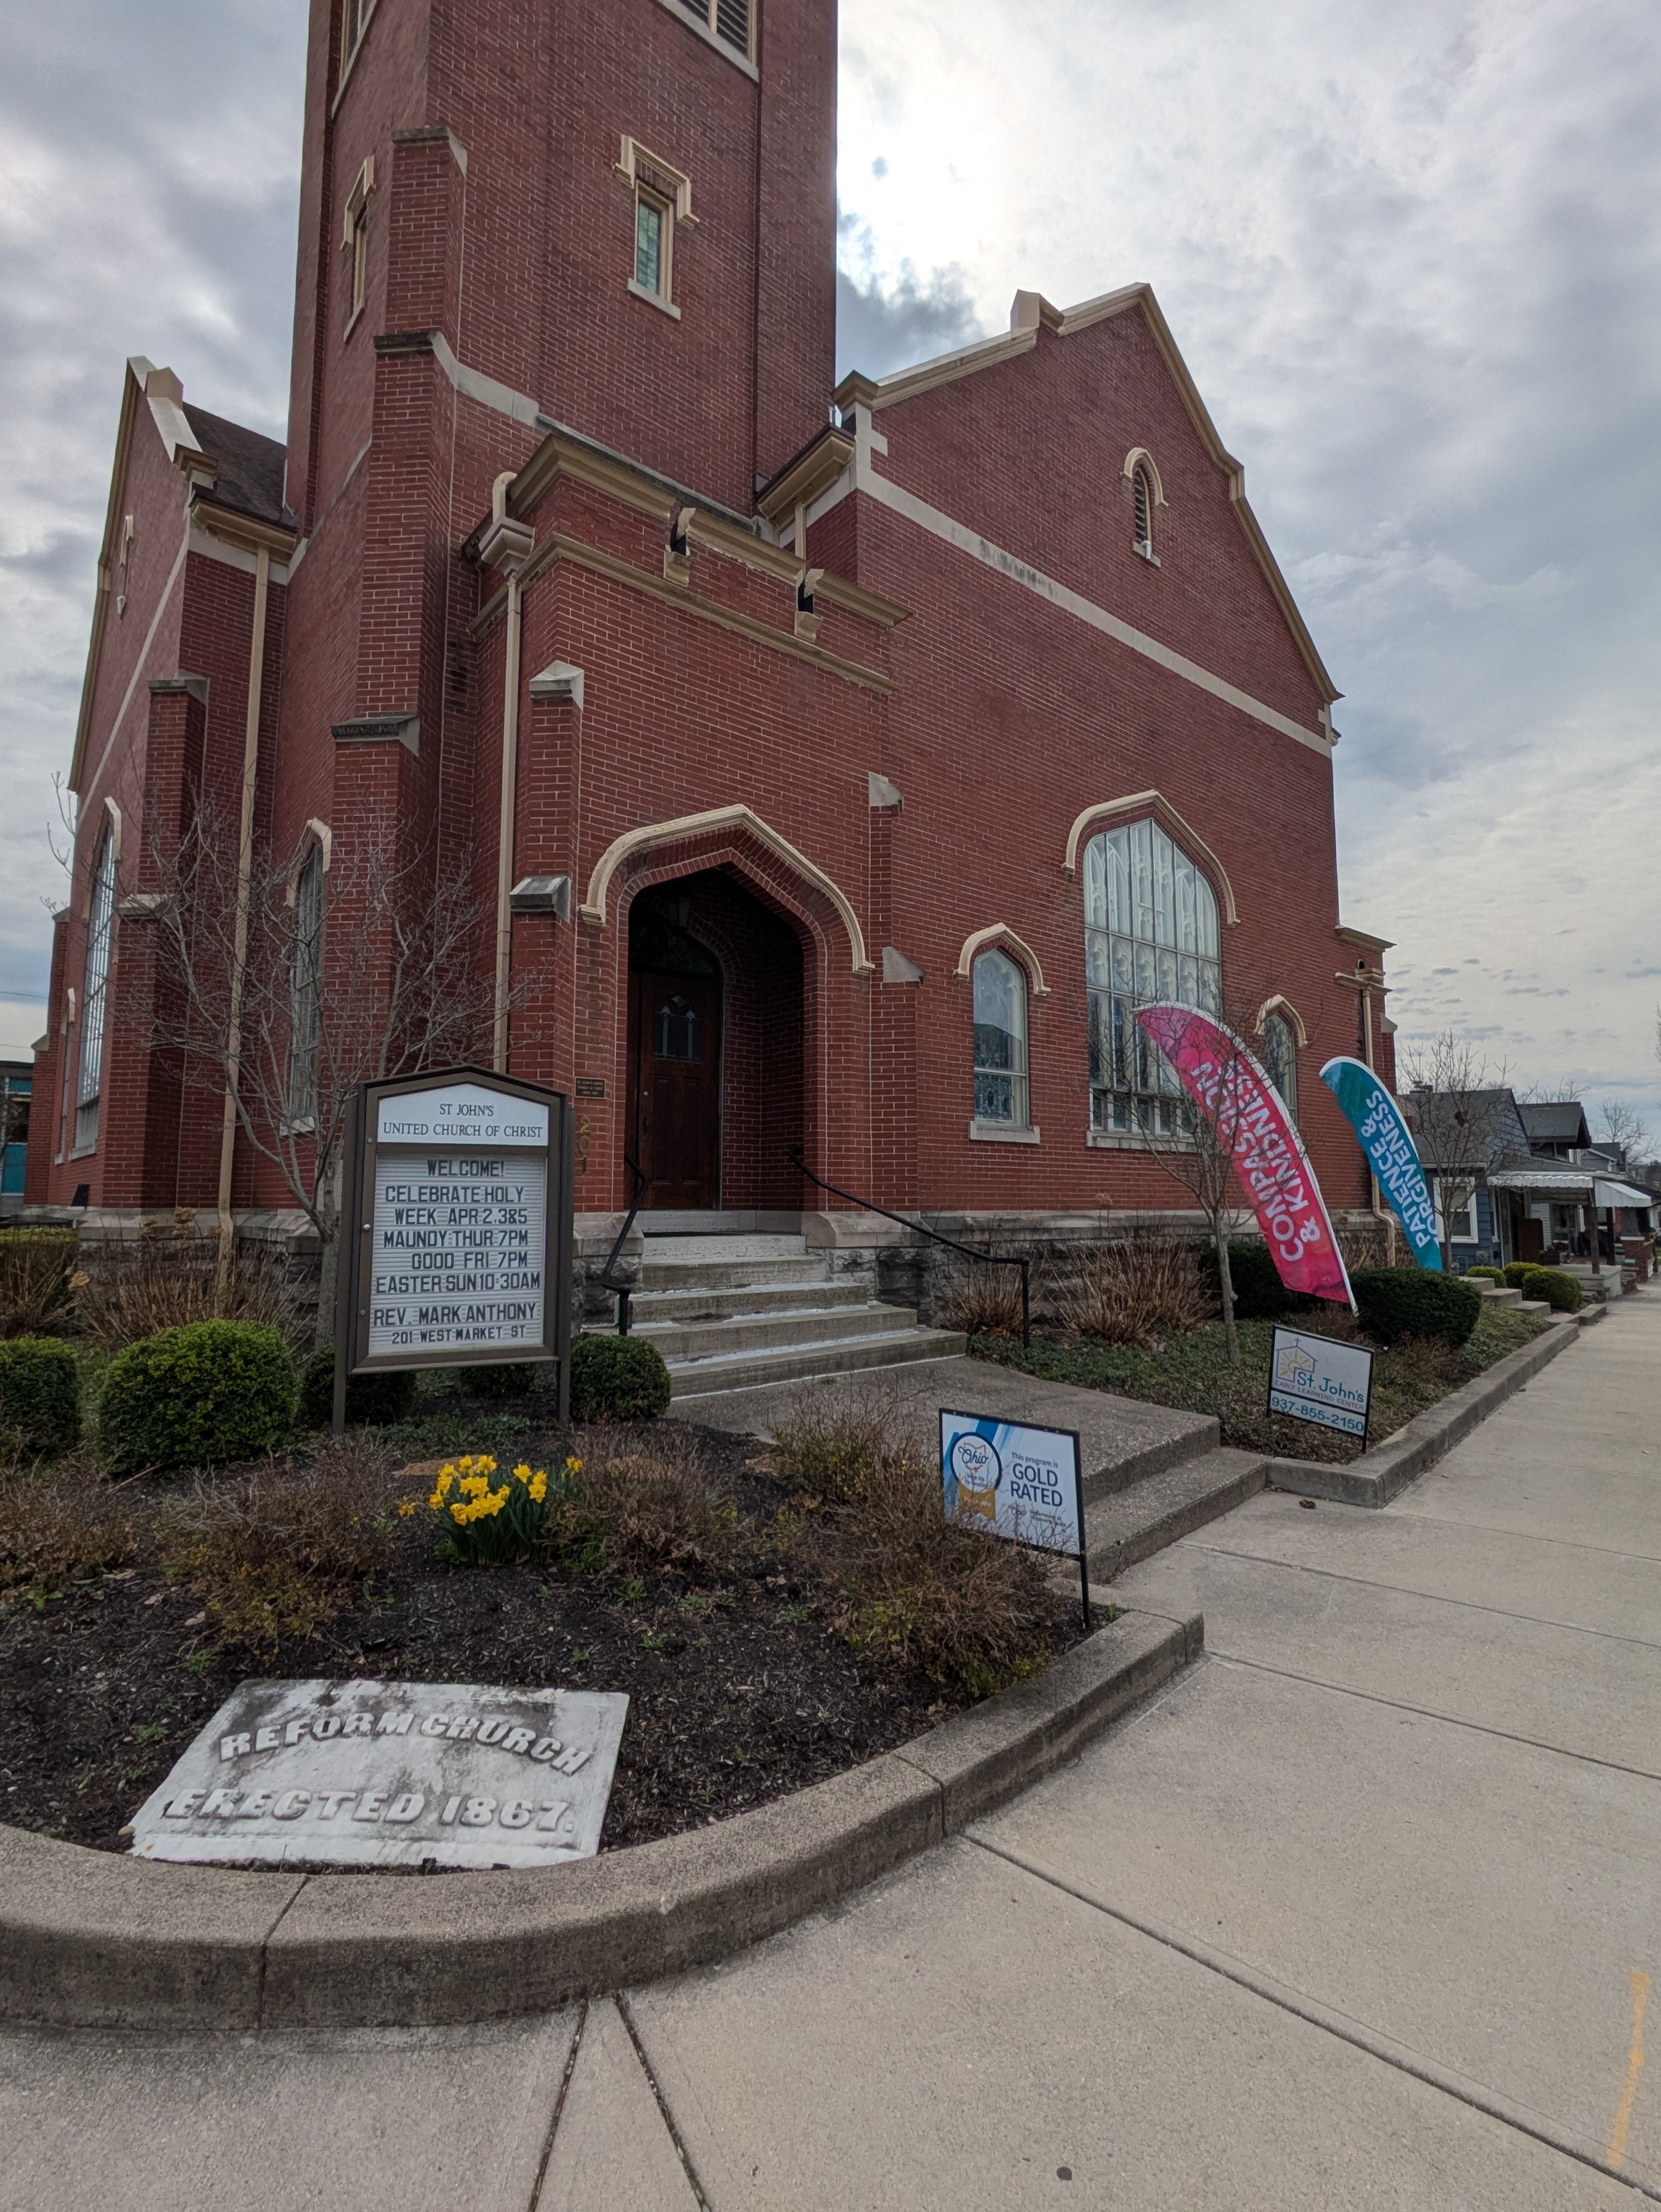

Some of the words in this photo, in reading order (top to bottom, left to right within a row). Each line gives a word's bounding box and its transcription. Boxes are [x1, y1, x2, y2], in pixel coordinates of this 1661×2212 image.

[440, 1104, 453, 1115] ST
[456, 1104, 494, 1117] JOHN'S
[383, 1123, 428, 1135] UNITED
[433, 1124, 481, 1136] CHURCH
[486, 1126, 500, 1137] OF
[504, 1126, 543, 1138] CHRIST
[1361, 1115, 1377, 1137] &
[427, 1160, 505, 1177] WELCOME!
[386, 1186, 480, 1203] CELEBRATE
[485, 1186, 524, 1202] HOLY
[1370, 1138, 1430, 1248] PATIENCE
[394, 1208, 436, 1225] WEEK
[448, 1208, 478, 1224] APR
[384, 1230, 447, 1248] MAUNDY
[453, 1230, 493, 1246] THUR
[498, 1230, 528, 1246] 7PM
[1300, 1217, 1320, 1242] &
[411, 1253, 454, 1269] GOOD
[464, 1252, 489, 1268] FRI
[498, 1251, 528, 1268] 7PM
[376, 1275, 441, 1293] EASTER
[445, 1274, 476, 1291] SUN
[374, 1308, 411, 1326] REV.
[419, 1306, 461, 1324] MARK
[466, 1303, 536, 1321] ANTHONY
[392, 1331, 412, 1344] 201
[420, 1329, 452, 1342] WEST
[455, 1327, 502, 1340] MARKET
[511, 1325, 525, 1338] ST
[1275, 1380, 1296, 1390] EARLY
[1298, 1386, 1334, 1402] LEARNING
[1337, 1396, 1363, 1410] CENTER
[1319, 1377, 1364, 1403] John's
[1272, 1397, 1364, 1432] 937-855-2150
[958, 1446, 989, 1464] Ohio
[1011, 1452, 1023, 1460] This
[1025, 1456, 1052, 1467] program
[1013, 1463, 1058, 1486] GOLD
[1010, 1481, 1063, 1506] RATED
[220, 1712, 415, 1762] REFORM
[420, 1714, 590, 1776] CHURCH
[164, 1789, 426, 1824] ERECTED
[440, 1796, 574, 1832] 1867.
